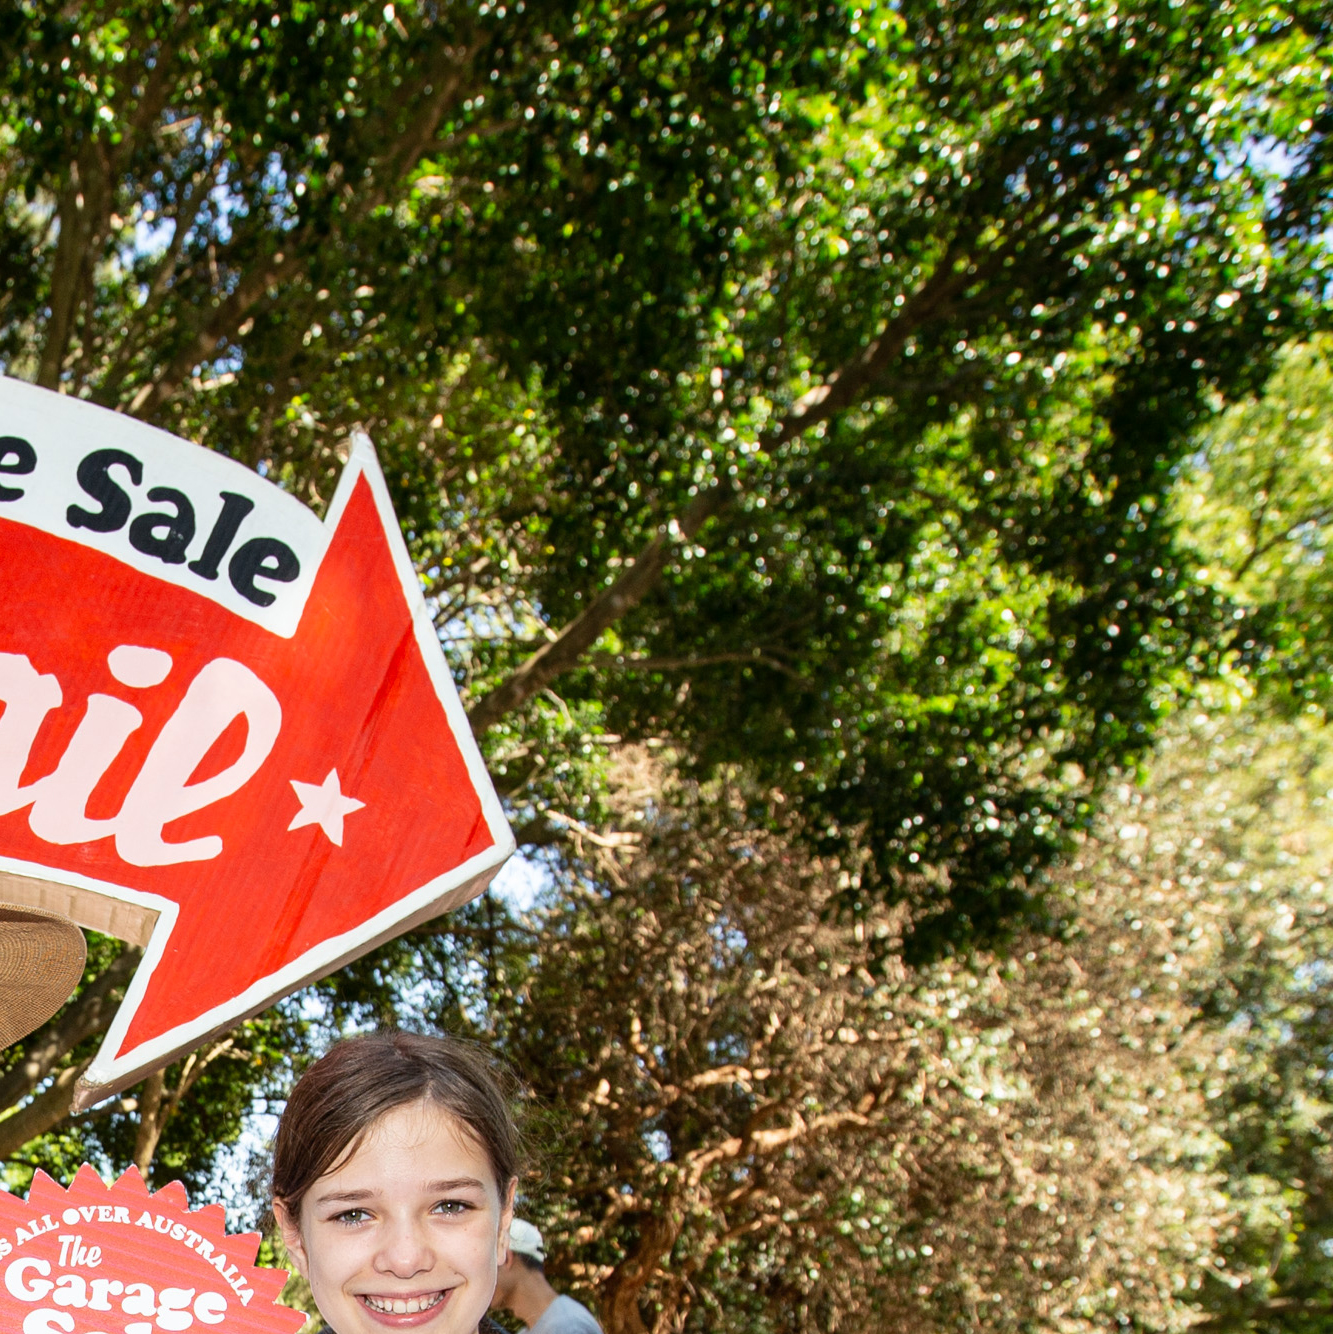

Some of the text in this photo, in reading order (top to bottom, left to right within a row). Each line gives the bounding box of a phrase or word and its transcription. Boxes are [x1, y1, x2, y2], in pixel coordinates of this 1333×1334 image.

[66, 448, 301, 608] Sale
[4, 1257, 228, 1331] Garage
[15, 1214, 60, 1247] ALL
[62, 1204, 130, 1226] OVER
[134, 1210, 256, 1307] AUSTRALIA
[57, 1234, 102, 1268] The
